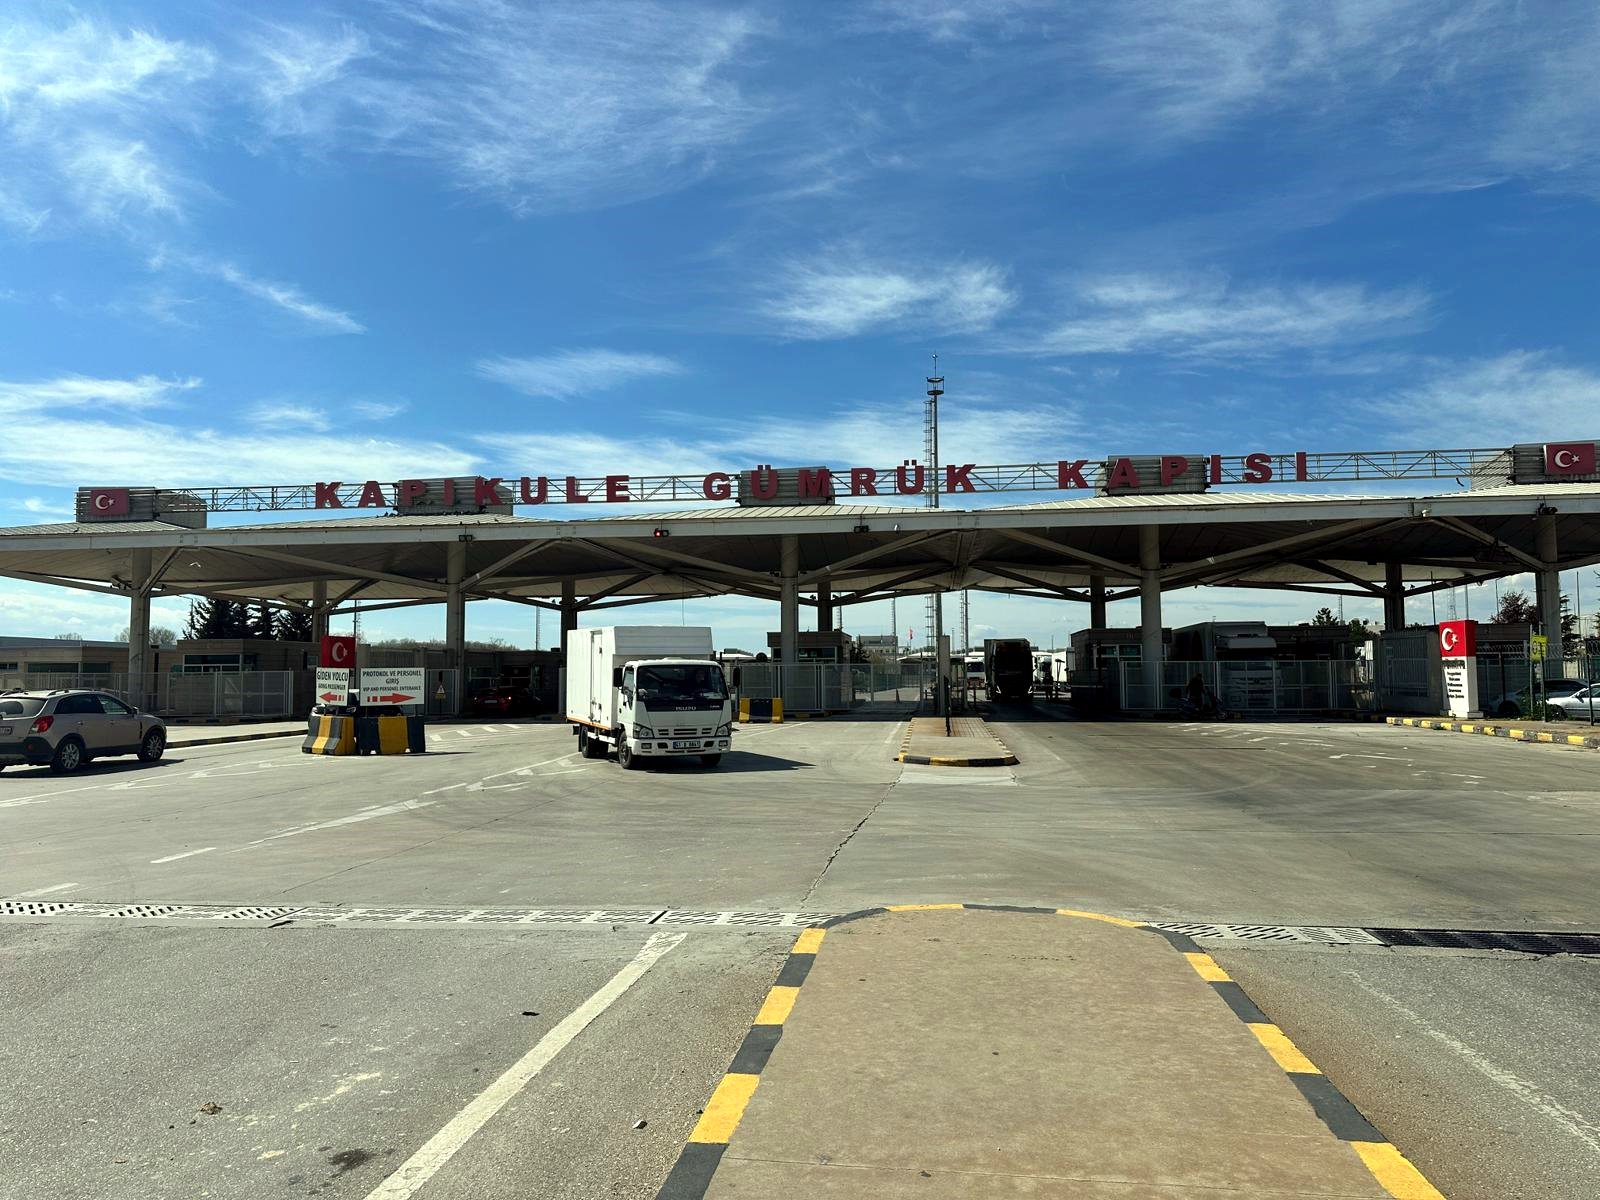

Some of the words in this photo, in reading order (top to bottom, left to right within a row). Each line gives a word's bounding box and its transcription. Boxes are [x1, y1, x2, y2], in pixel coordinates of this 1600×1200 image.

[315, 474, 630, 509] KAPIKULE
[703, 460, 976, 501] GÜMRÜK
[1057, 451, 1307, 489] KAPISI
[332, 671, 348, 681] YOLCU
